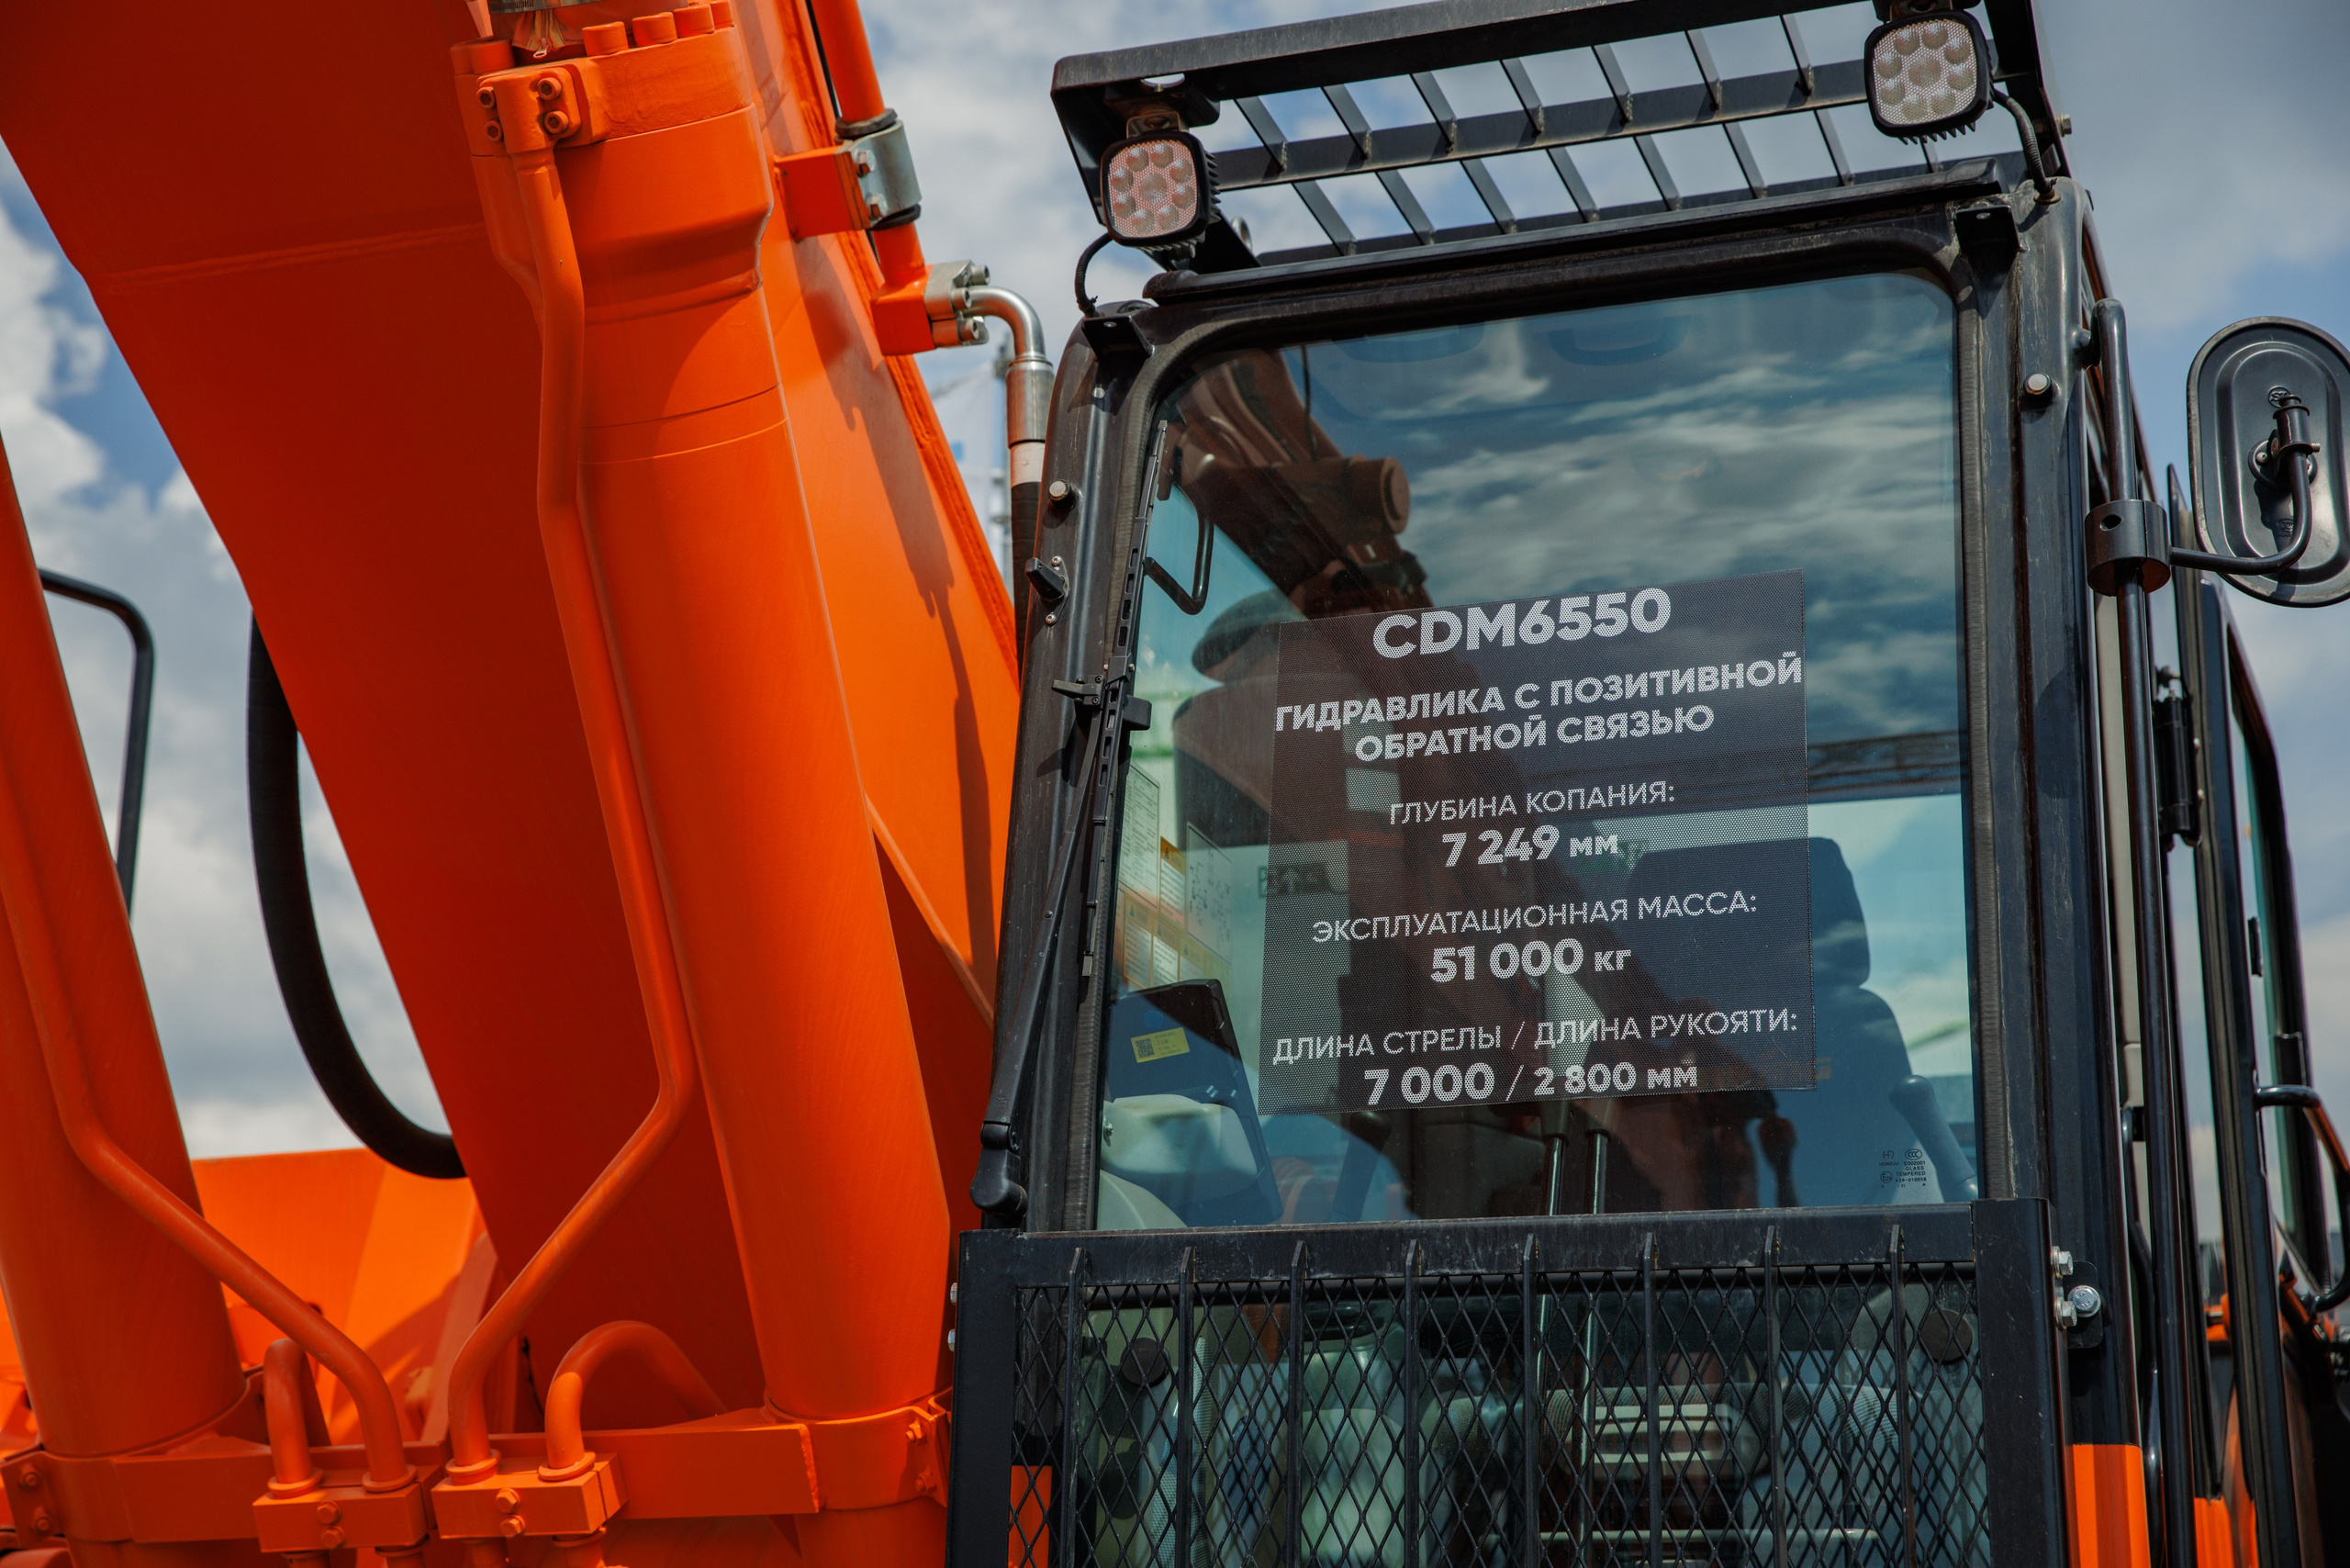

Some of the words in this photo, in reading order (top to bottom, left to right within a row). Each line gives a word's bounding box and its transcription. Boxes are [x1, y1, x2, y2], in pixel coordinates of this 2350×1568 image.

[1373, 588, 1672, 658] CDM6550
[1275, 688, 1505, 733] ГИДРАВЛИКА
[1515, 682, 1541, 709] С
[1550, 650, 1803, 707] ПОЗИТИВНОЙ
[1354, 714, 1548, 762] ОБРАТНОЙ
[1556, 704, 1715, 744] СВЯЗЬЮ
[1390, 796, 1517, 825] ГЛУБИНА
[1526, 780, 1675, 814] КОПАНИЯ:
[1442, 832, 1468, 868] 7
[1477, 824, 1561, 865] 249
[1570, 834, 1618, 857] мм
[1312, 898, 1628, 944] ЭКСПЛУАТАЦИОННАЯ
[1638, 890, 1757, 919] МАССА:
[1430, 946, 1475, 983] 51
[1489, 937, 1584, 980] 000
[1595, 947, 1632, 972] кг
[1272, 1033, 1375, 1065] ДЛИНА
[1382, 1025, 1501, 1056] СТРЕЛЫ
[1511, 1020, 1526, 1050] /
[1534, 1014, 1642, 1048] ДЛИНА
[1651, 1006, 1797, 1038] РУКОЯТИ:
[1364, 1069, 1391, 1105] 7
[1401, 1061, 1495, 1103] 000
[1505, 1064, 1525, 1102] /
[1534, 1067, 1555, 1095] 2
[1564, 1061, 1638, 1093] 800
[1647, 1065, 1698, 1089] мм
